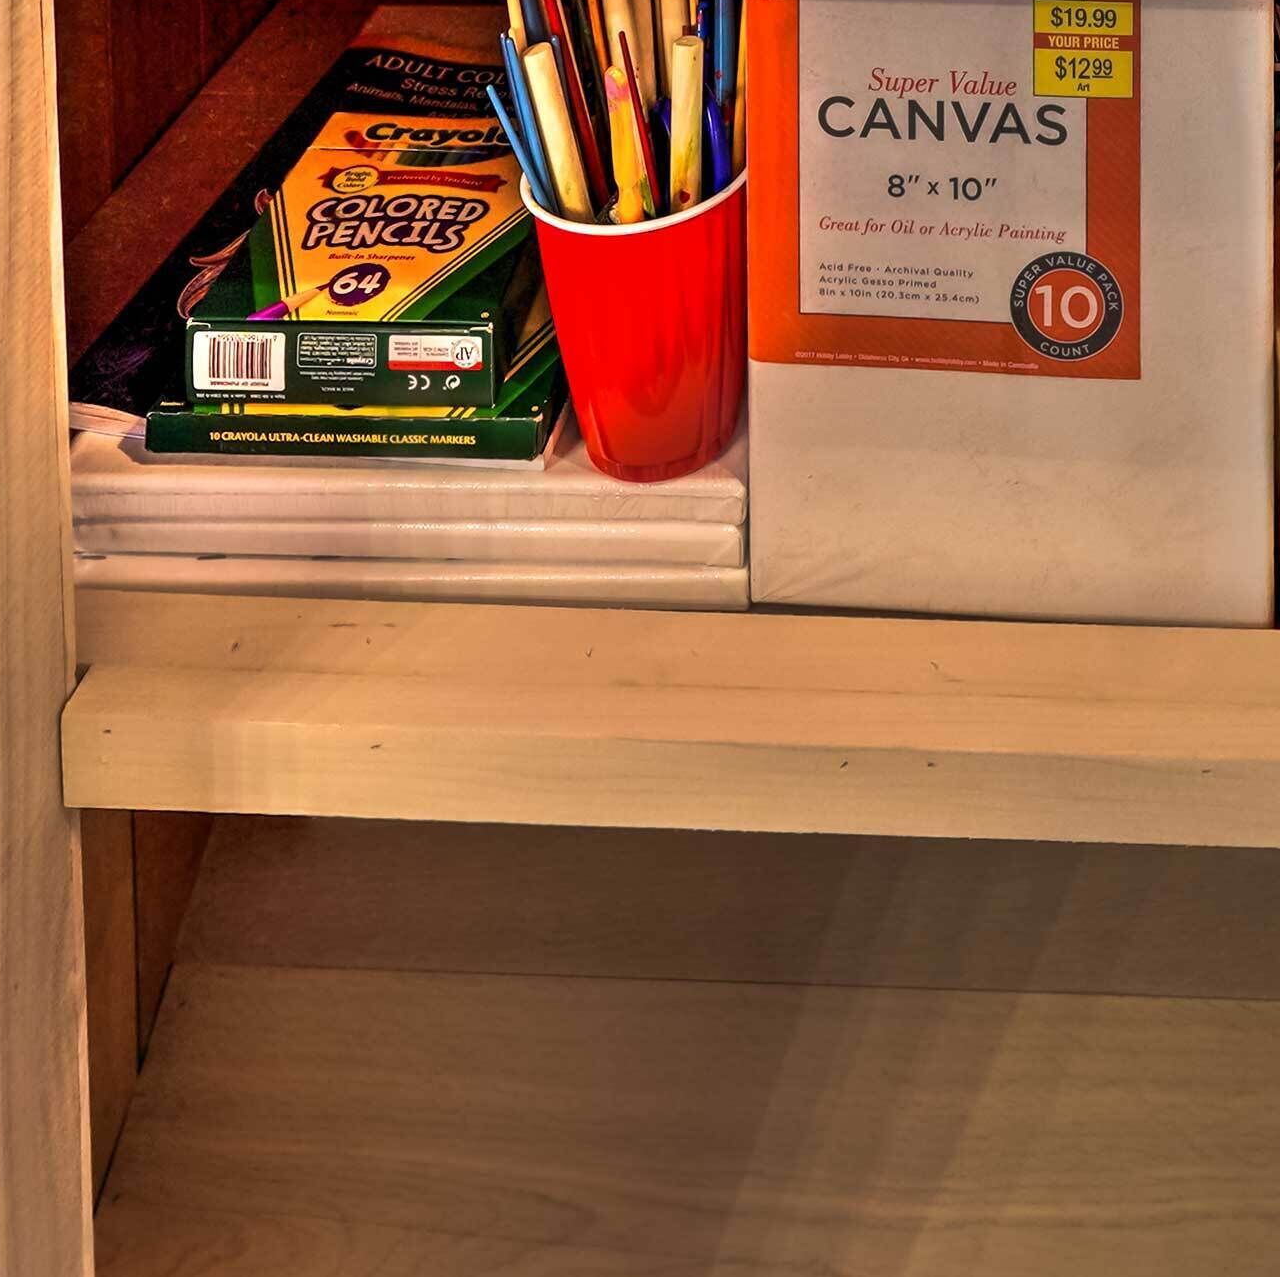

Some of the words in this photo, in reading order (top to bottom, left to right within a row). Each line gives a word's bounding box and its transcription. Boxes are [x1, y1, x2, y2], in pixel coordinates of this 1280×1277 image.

[1050, 7, 1118, 29] $19.99
[1047, 35, 1081, 49] YOUR
[1083, 36, 1120, 50] PRICE
[364, 54, 454, 80] ADULT
[400, 77, 457, 98] Stress
[867, 66, 939, 99] Super
[949, 69, 1017, 96] Value
[1076, 82, 1091, 92] Art
[346, 82, 404, 103] Animals,
[409, 94, 478, 111] Mandalas,
[817, 95, 1068, 147] CANVAS
[887, 173, 921, 199] 8"
[927, 180, 940, 197] x
[949, 176, 997, 201] 10"
[311, 197, 485, 222] COLORED
[306, 221, 464, 250] PENCILS
[818, 216, 860, 232] Great
[860, 217, 887, 237] for
[890, 219, 915, 234] Oil
[919, 224, 935, 235] or
[938, 221, 994, 241] Acrylic
[997, 223, 1067, 245] Painting
[328, 253, 365, 261] Built-In
[368, 254, 416, 262] Sharpener
[819, 262, 844, 272] Acid
[847, 263, 872, 273] Free
[884, 265, 930, 276] Archival
[933, 267, 974, 279] Quality
[819, 275, 857, 286] Acrylic
[861, 277, 895, 287] Gesso
[898, 278, 938, 289] Primed
[332, 272, 382, 294] 64
[1014, 263, 1043, 308] SUPER
[1044, 255, 1096, 273] VALUE
[1096, 273, 1120, 311] PACK
[1034, 284, 1098, 329] 10
[1040, 341, 1090, 357] COUNT
[209, 431, 220, 441] 10
[221, 431, 267, 442] CRAYOLA
[268, 432, 334, 443] ULTRA-CLEAN
[336, 433, 388, 444] WASHABLE
[389, 434, 428, 445] CLASSIC
[430, 435, 476, 445] MARKERS
